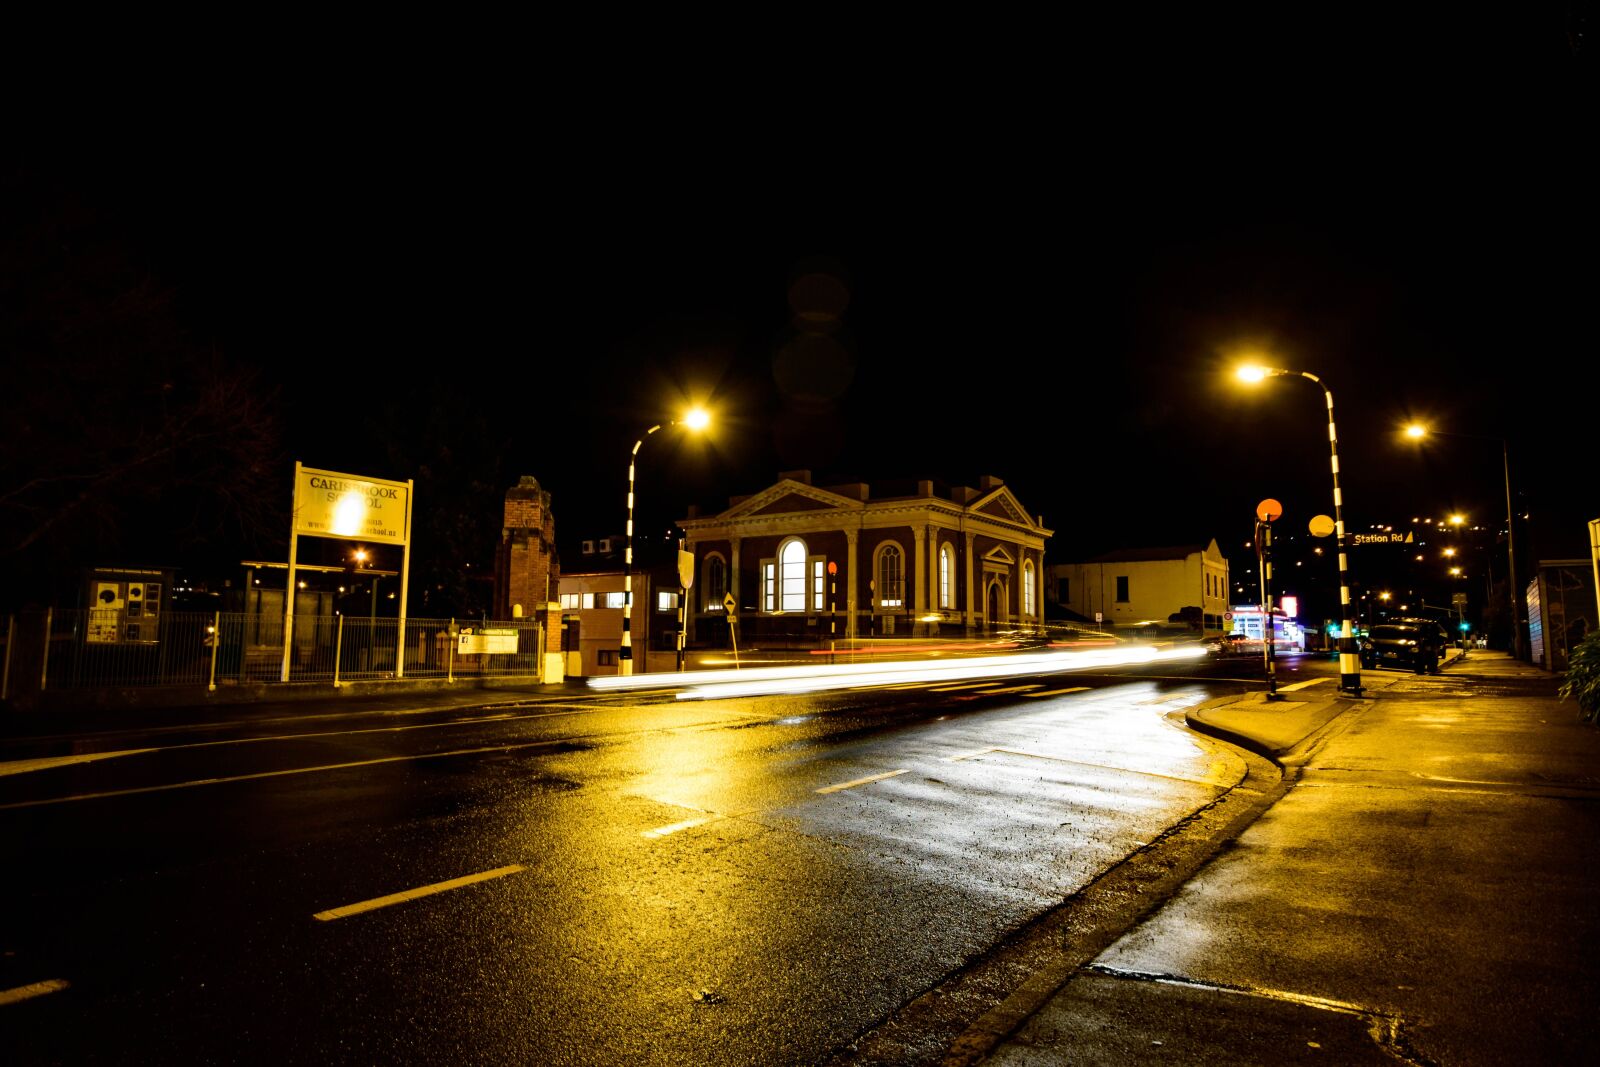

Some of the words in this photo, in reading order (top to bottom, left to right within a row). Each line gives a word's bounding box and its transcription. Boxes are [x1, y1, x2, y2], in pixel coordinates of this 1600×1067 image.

[327, 492, 382, 508] SOL
[1355, 534, 1388, 544] Station
[1391, 533, 1403, 542] Rd
